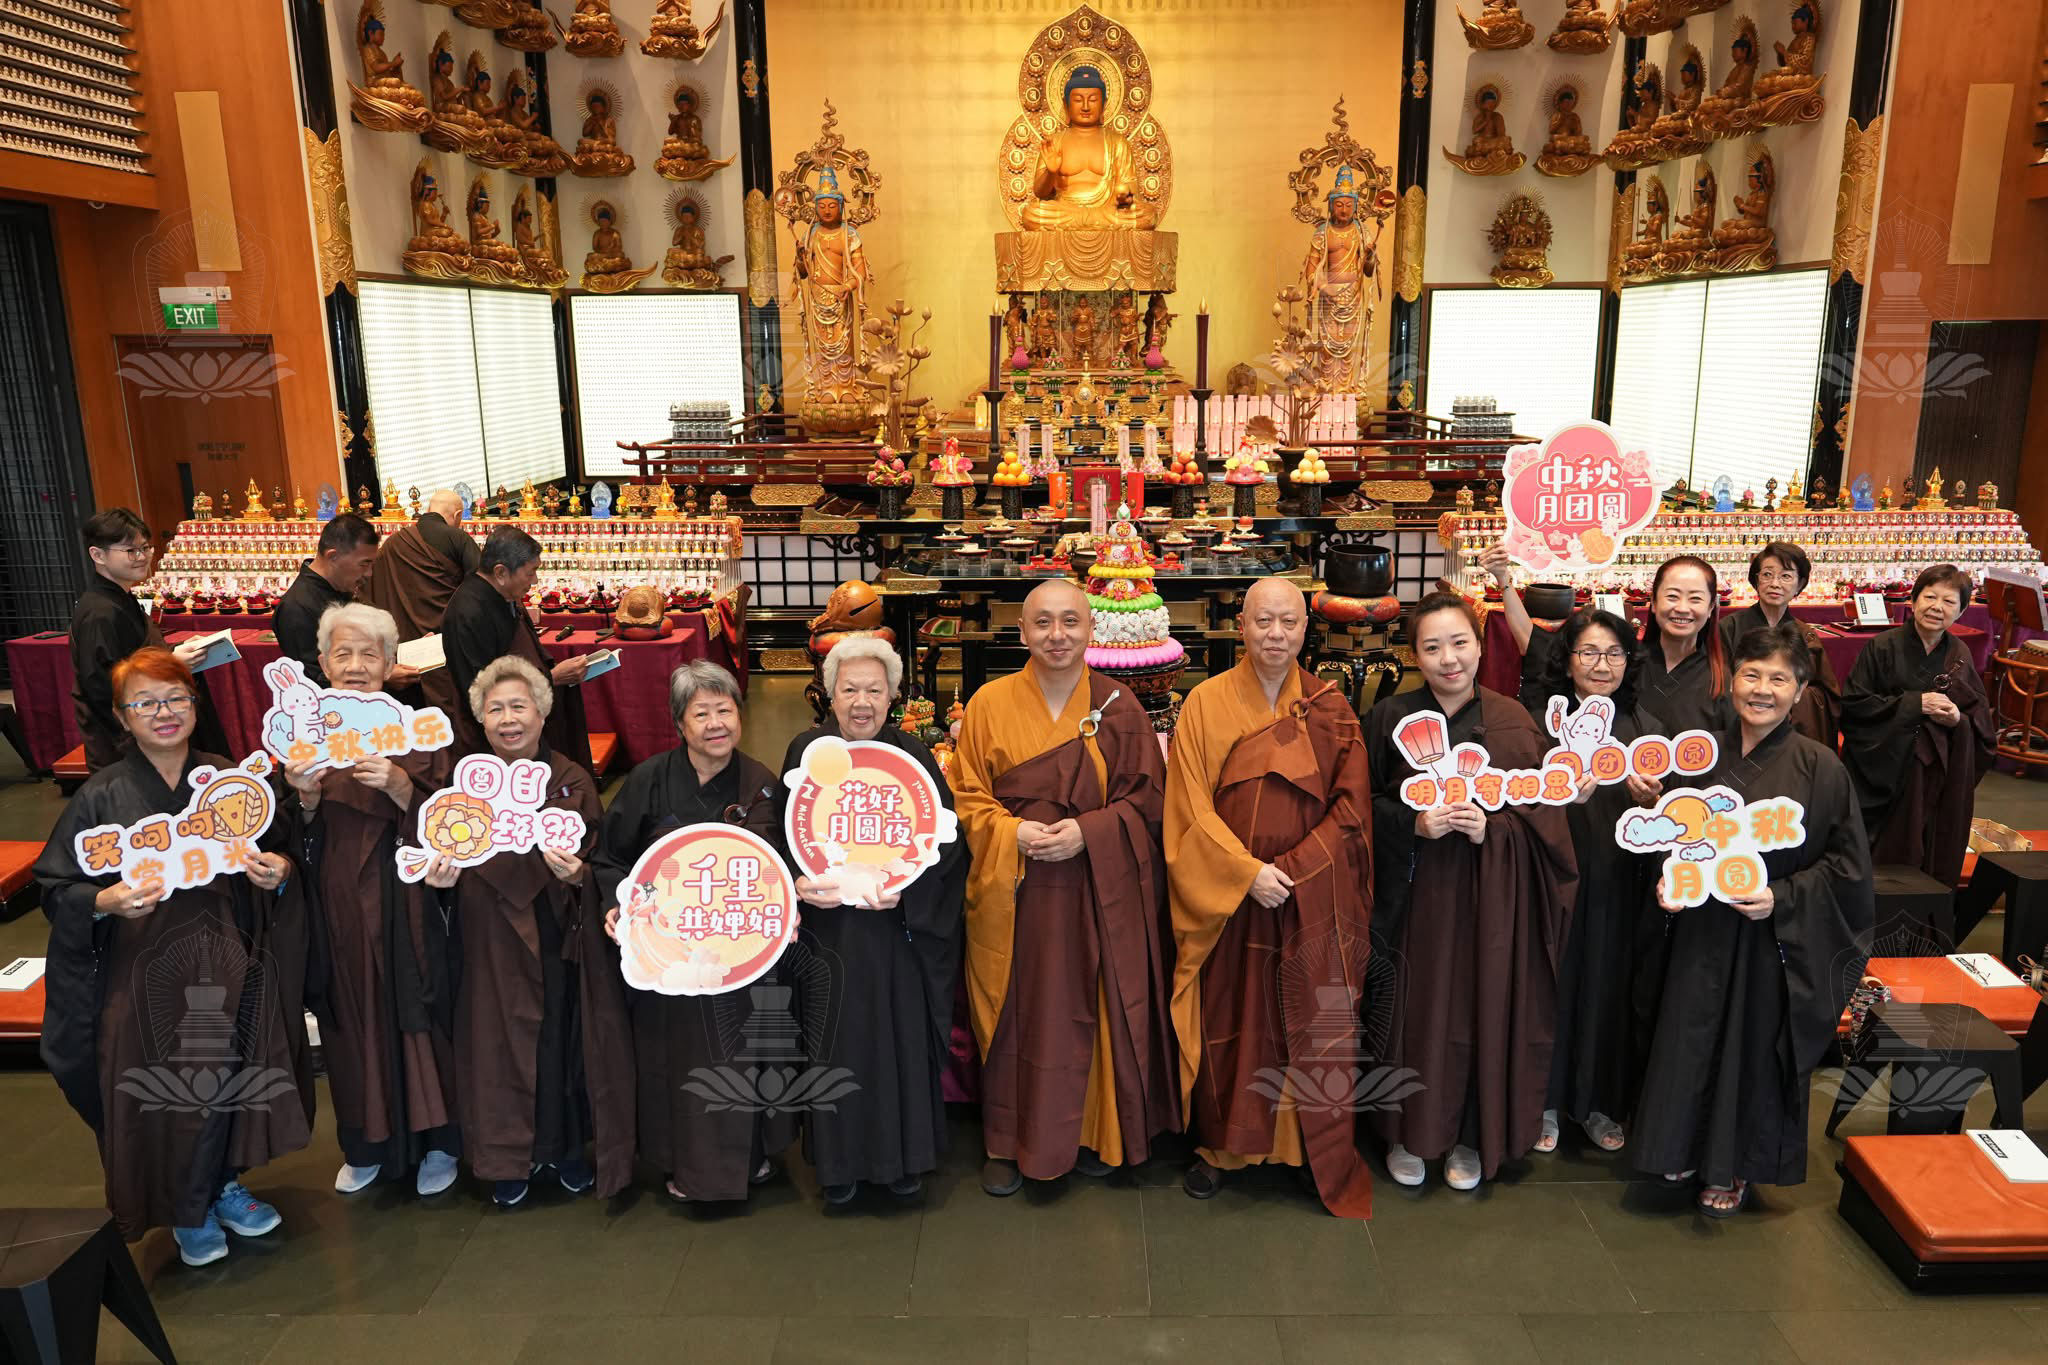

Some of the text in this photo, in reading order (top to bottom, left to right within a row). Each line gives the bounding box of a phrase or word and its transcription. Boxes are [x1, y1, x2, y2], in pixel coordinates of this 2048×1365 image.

[174, 307, 205, 325] EXIT
[1539, 454, 1621, 495] 中秋
[1537, 492, 1627, 525] 月团圆
[288, 714, 448, 762] 中秋快乐
[460, 759, 545, 803] 月圆
[837, 780, 903, 815] 花好
[911, 780, 931, 819] Festival
[1406, 770, 1578, 806] 明月寄相思
[83, 809, 215, 870] 笑呵呵
[490, 809, 580, 850] 花好
[829, 813, 912, 847] 月圆夜
[1705, 806, 1798, 848] 中秋
[682, 854, 763, 905] 千里
[1671, 856, 1760, 899] 月圆
